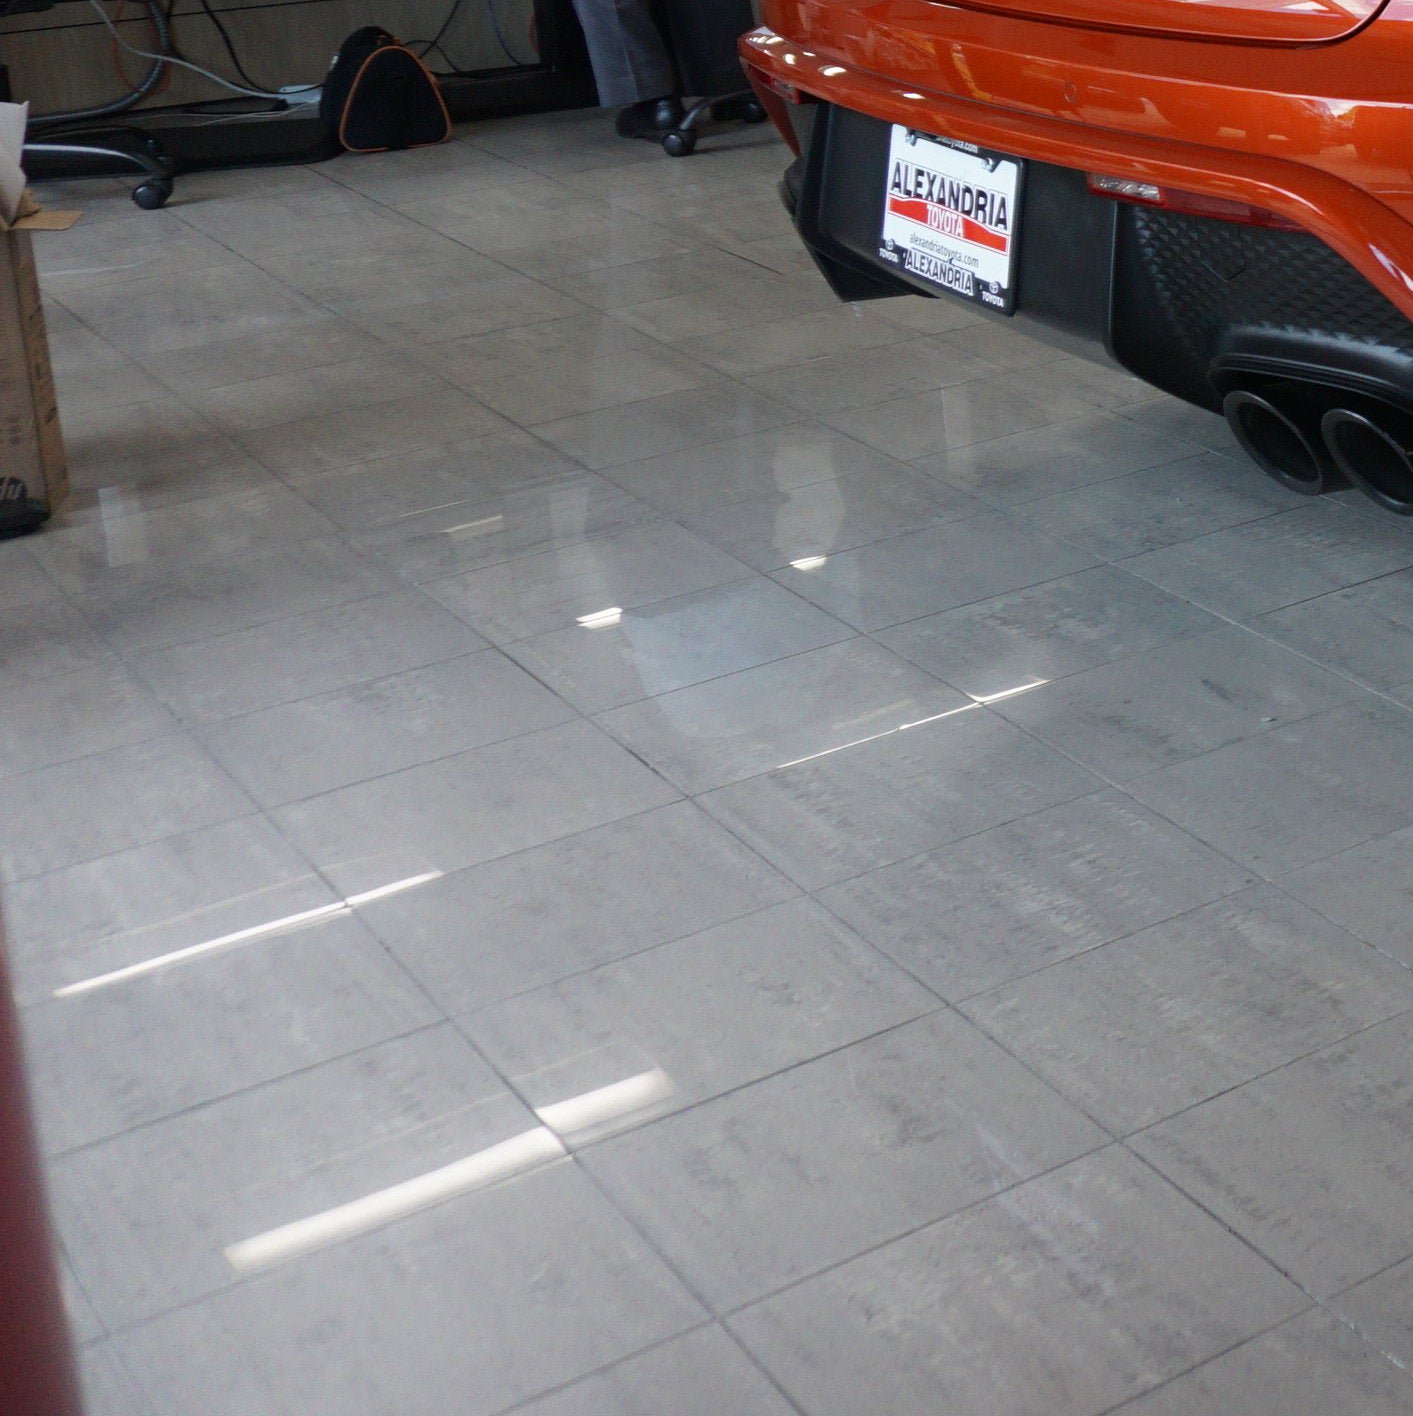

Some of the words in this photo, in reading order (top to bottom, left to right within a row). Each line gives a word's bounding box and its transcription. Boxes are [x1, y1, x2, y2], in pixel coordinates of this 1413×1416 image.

[891, 161, 1008, 231] ALEXANDRIA
[926, 204, 964, 239] TOYOTA
[879, 247, 900, 264] TOYOTA
[909, 231, 979, 268] alexandriatoyota.com
[904, 248, 975, 297] ALEXANDRIA
[981, 290, 1005, 308] TOYOTA
